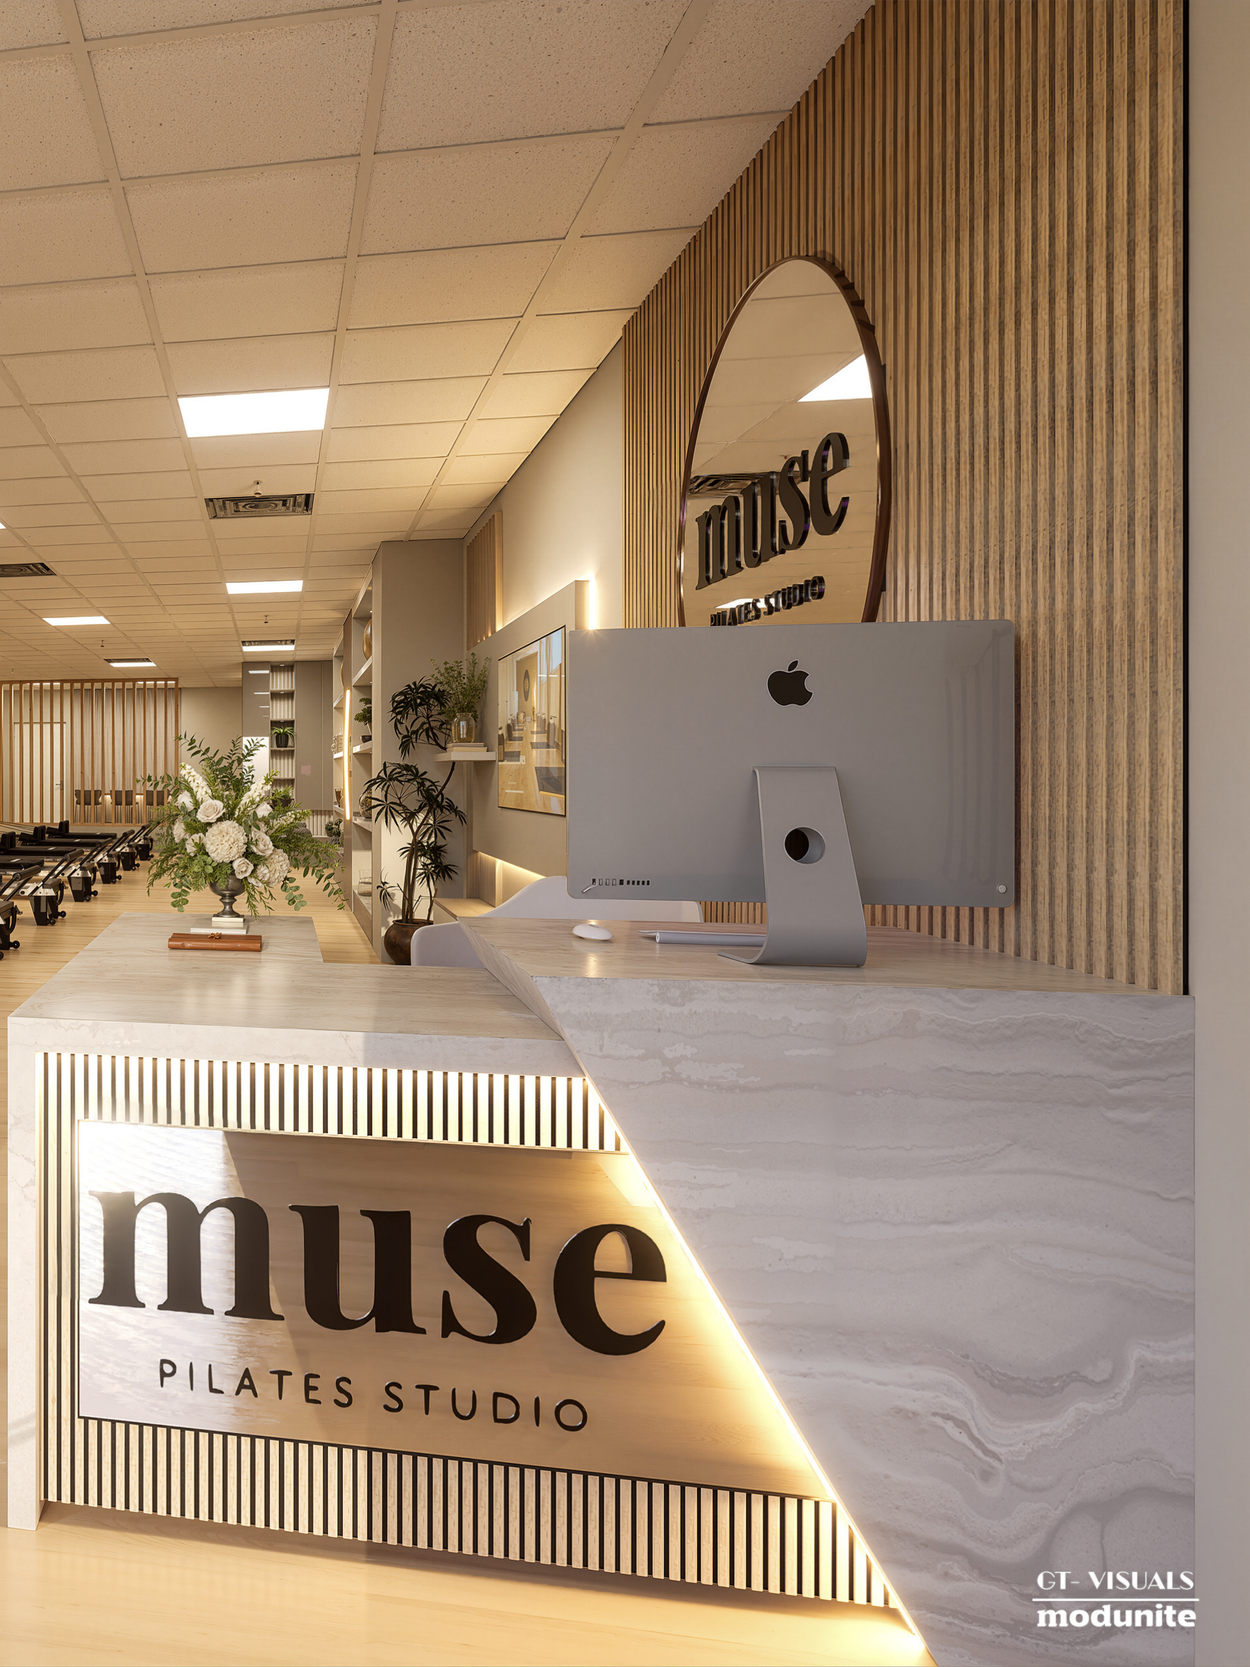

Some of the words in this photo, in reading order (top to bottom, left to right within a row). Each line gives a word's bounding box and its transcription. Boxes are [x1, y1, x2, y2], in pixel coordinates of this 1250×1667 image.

[695, 432, 850, 590] muse
[763, 576, 826, 616] STUDIO
[87, 1189, 667, 1356] muse
[159, 1358, 353, 1408] PILATES
[382, 1380, 588, 1432] STUDIO
